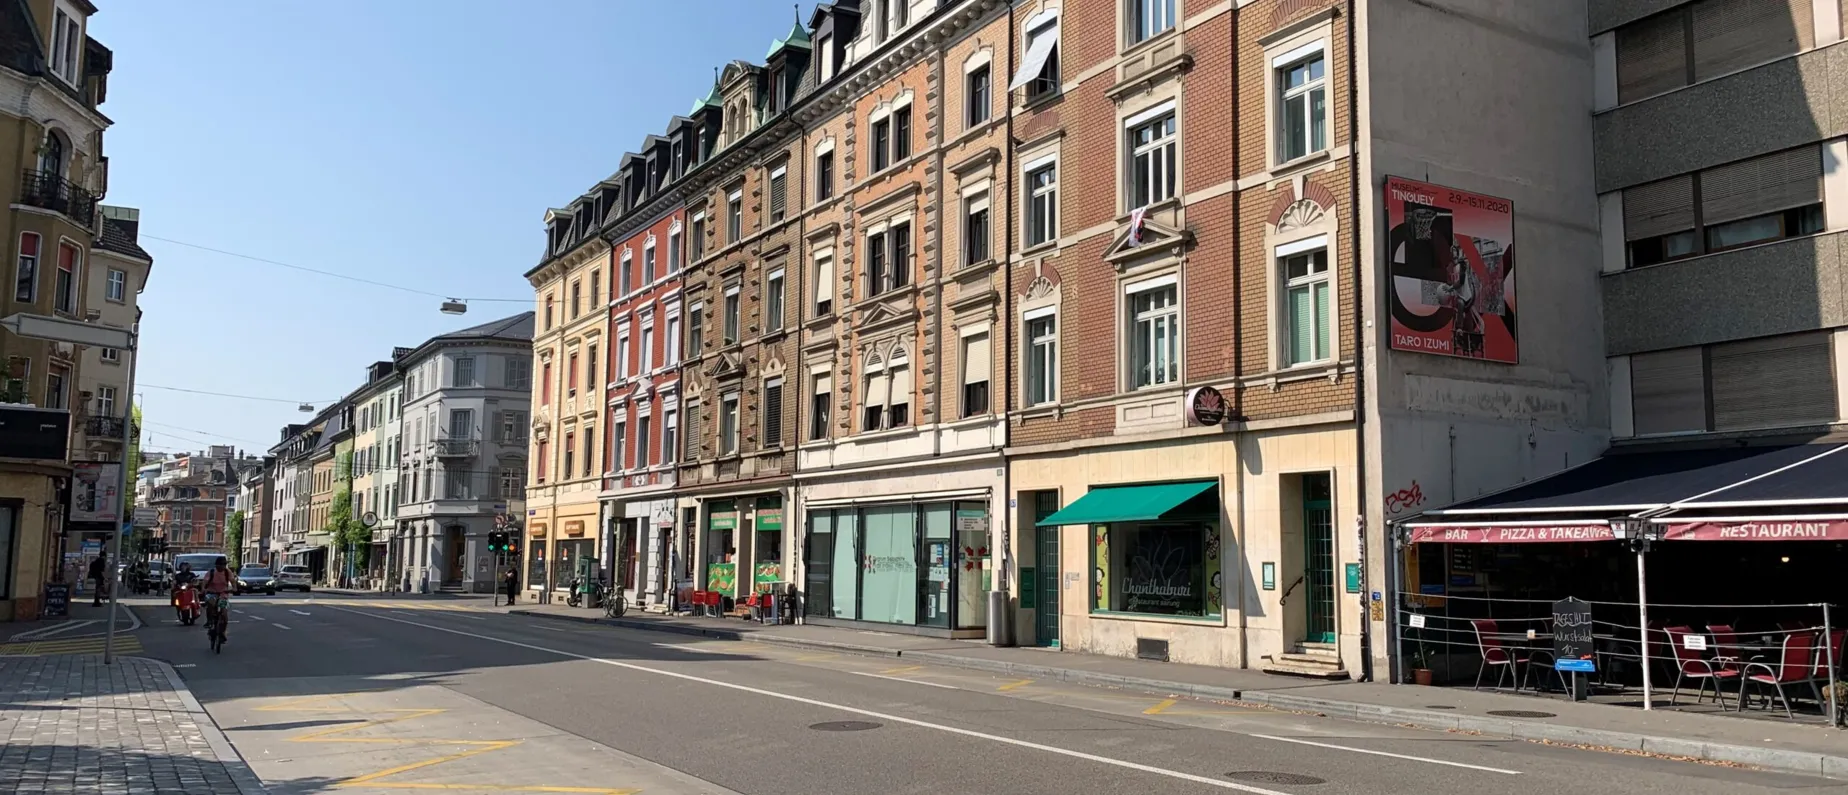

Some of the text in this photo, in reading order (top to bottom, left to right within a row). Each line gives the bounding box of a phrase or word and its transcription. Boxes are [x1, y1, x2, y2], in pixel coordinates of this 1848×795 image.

[1391, 182, 1420, 192] MUSEUM
[1391, 189, 1435, 206] TINGUELY
[1395, 334, 1450, 351] TARO IZUMI
[1445, 529, 1469, 540] BAR
[1500, 528, 1535, 540] PIZZA
[1538, 528, 1547, 540] &
[1720, 523, 1830, 538] RESTAURANT
